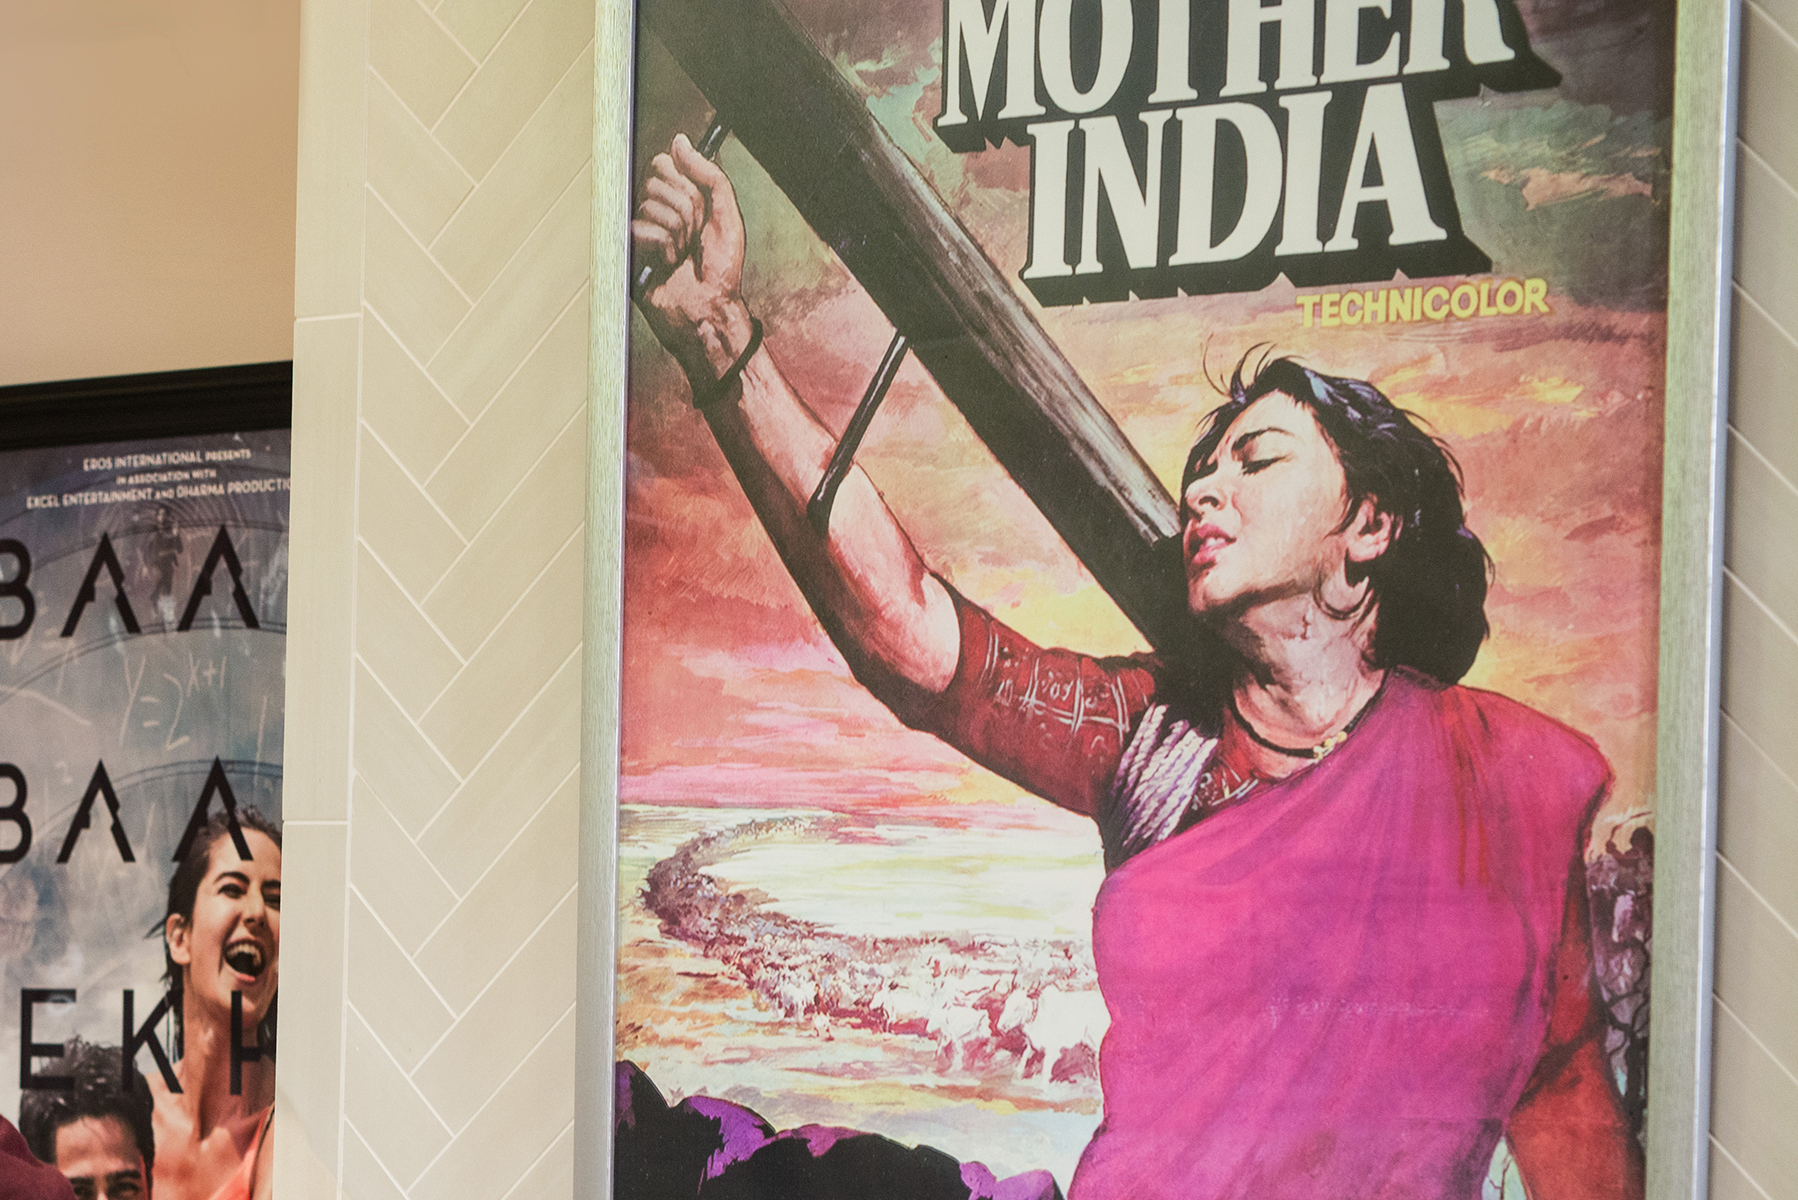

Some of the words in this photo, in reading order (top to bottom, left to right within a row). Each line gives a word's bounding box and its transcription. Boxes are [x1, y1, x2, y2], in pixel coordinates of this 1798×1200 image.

[1021, 83, 1448, 281] INDIA
[1296, 278, 1550, 328] TECHNICOLOR
[114, 450, 203, 469] INTERNATIONAL
[26, 494, 60, 509] EXCEL
[62, 487, 153, 508] ENTERTAINMENT
[176, 483, 225, 499] DHARMA
